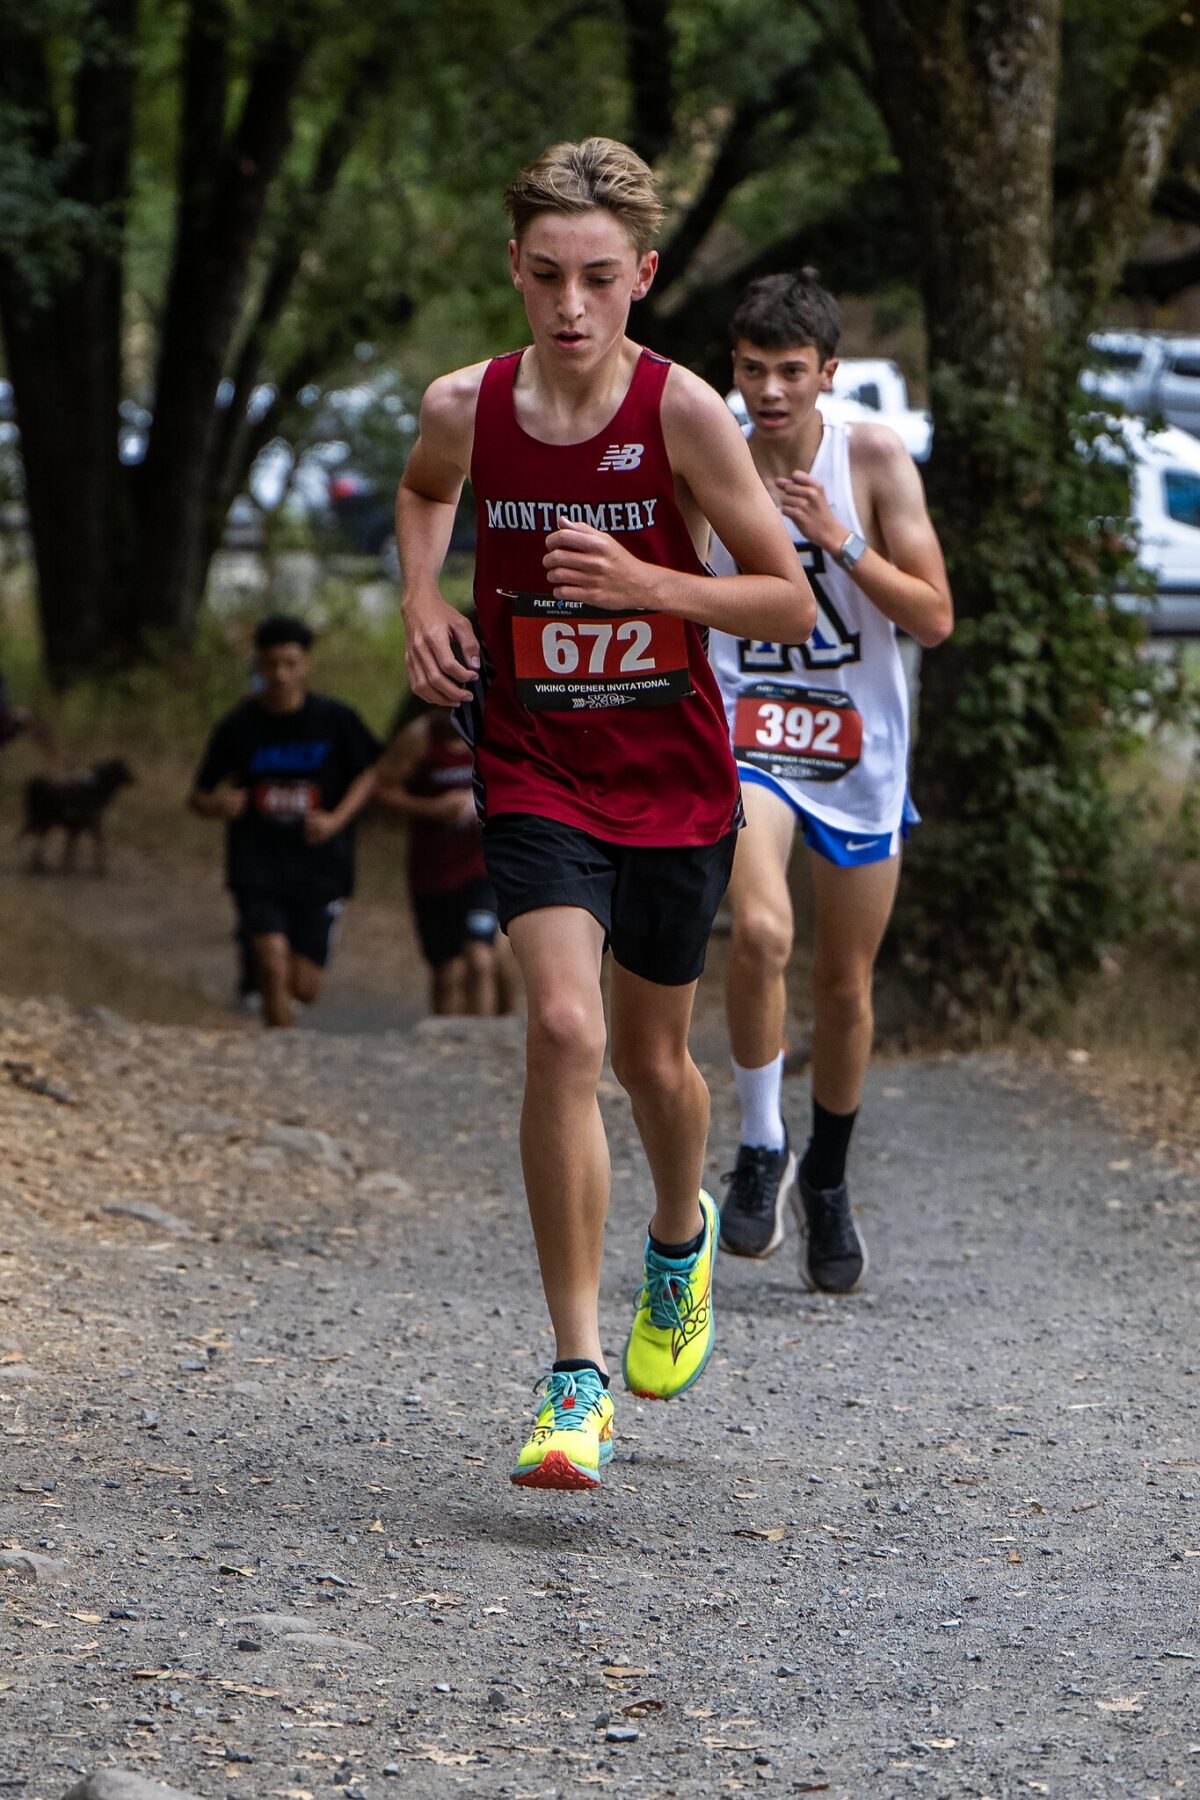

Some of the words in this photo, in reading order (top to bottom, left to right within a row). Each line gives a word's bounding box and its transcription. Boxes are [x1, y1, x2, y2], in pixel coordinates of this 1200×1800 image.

[485, 498, 658, 531] MONTGOMERY
[533, 599, 556, 607] FLEET
[541, 620, 656, 674] 672
[534, 684, 566, 693] VIKING
[568, 683, 605, 693] OPENER
[607, 678, 670, 692] INVITATIONAL
[756, 703, 841, 753] 392
